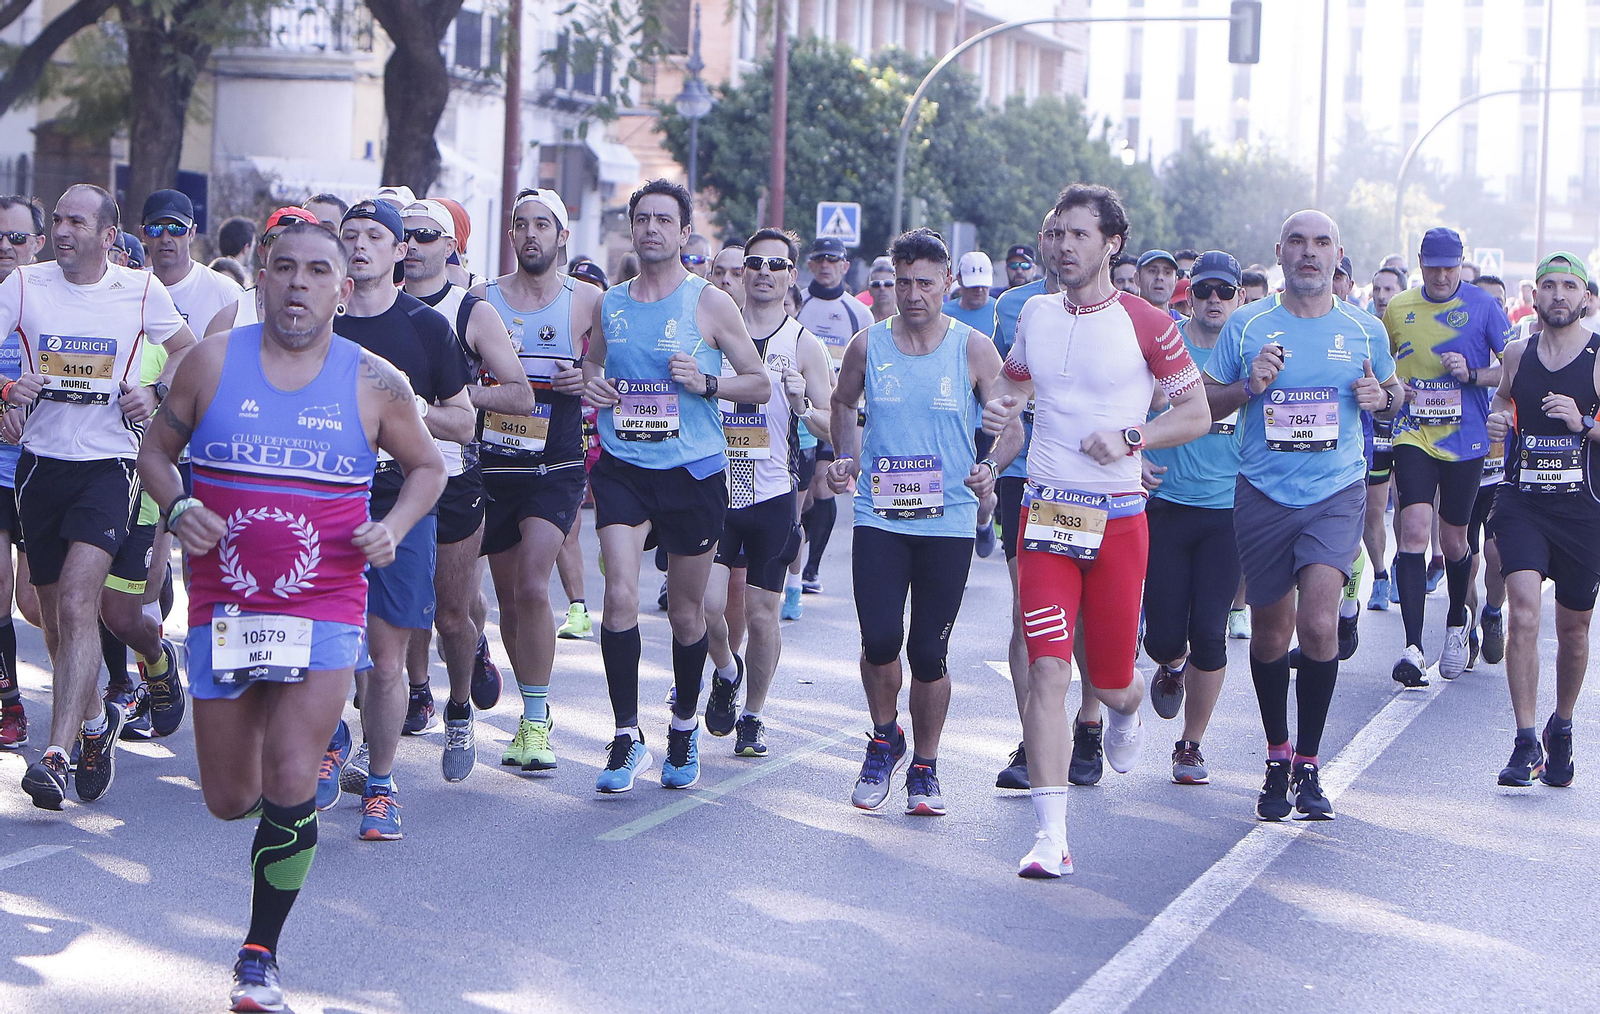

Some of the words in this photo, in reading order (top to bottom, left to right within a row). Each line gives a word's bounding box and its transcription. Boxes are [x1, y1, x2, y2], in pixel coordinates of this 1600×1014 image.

[64, 340, 108, 352] ZURICH
[63, 364, 93, 375] 4110
[61, 379, 91, 390] MURIEL
[631, 382, 669, 392] ZURICH
[1288, 392, 1329, 401] ZURICH
[1425, 398, 1446, 406] 6566
[633, 405, 658, 415] 7849
[297, 416, 343, 431] apyou
[622, 418, 643, 428] LÓPEZ
[645, 420, 669, 429] RUBIO
[725, 416, 762, 425] ZURICH
[1288, 414, 1317, 425] 7847
[501, 421, 527, 435] 3419
[1291, 430, 1313, 439] JARO
[232, 433, 262, 444] CLUB
[264, 436, 331, 451] DEPORTIVO
[502, 436, 520, 447] LOLO
[1538, 438, 1573, 447] ZURICH
[205, 442, 357, 475] CREDUS
[1537, 459, 1562, 469] 2548
[892, 460, 933, 470] ZURICH
[1536, 473, 1562, 481] ALILOU
[893, 483, 921, 493] 7848
[892, 498, 922, 507] JUANRA
[1056, 490, 1101, 506] ZURICH
[1053, 513, 1082, 528] 4333
[1053, 530, 1073, 542] TETE
[242, 630, 286, 644] 10579
[249, 651, 272, 662] MEJI
